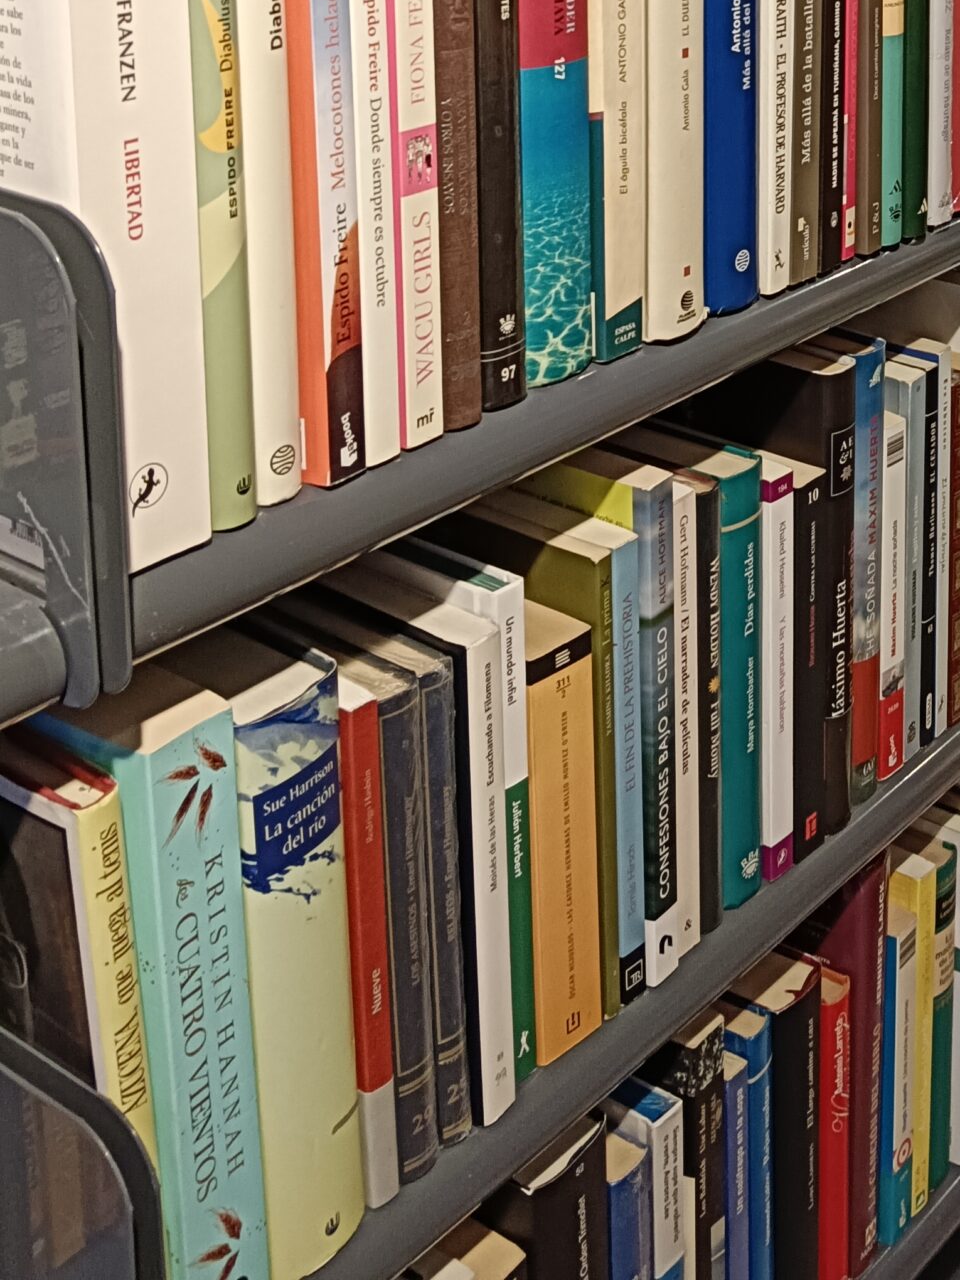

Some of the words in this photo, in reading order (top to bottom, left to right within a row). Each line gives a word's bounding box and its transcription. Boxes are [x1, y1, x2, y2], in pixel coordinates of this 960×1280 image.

[367, 39, 381, 93] Freire
[409, 34, 425, 106] FIONA
[553, 56, 566, 81] 127
[617, 23, 627, 83] ANTONIO
[776, 53, 787, 69] EL
[802, 54, 812, 70] la
[775, 72, 787, 133] PROFESOR
[802, 73, 812, 93] de
[325, 53, 347, 193] Melocotones
[369, 97, 385, 154] Donde
[619, 100, 628, 145] bicéfala
[802, 96, 812, 126] allá
[775, 135, 786, 152] DE
[801, 132, 812, 165] Más
[123, 136, 144, 242] LIBERTAD
[371, 157, 386, 222] siempre
[619, 184, 628, 195] El
[775, 155, 786, 215] HARVARD
[333, 202, 349, 268] Freire
[374, 227, 385, 241] es
[412, 211, 433, 295] GIRLS
[375, 246, 387, 308] octubre
[335, 270, 356, 345] Espido
[614, 322, 637, 336] ESPASA
[414, 309, 434, 387] WACU
[500, 364, 516, 383] 97
[777, 482, 789, 494] 194
[808, 487, 819, 506] 10
[680, 514, 688, 540] Gert
[680, 546, 689, 607] Hofmann
[505, 616, 514, 634] Un
[681, 615, 690, 632] El
[505, 637, 516, 675] mundo
[656, 626, 668, 684] CIELO
[681, 635, 690, 694] narrador
[507, 677, 516, 706] infiel
[658, 689, 668, 712] EL
[681, 698, 690, 716] de
[658, 716, 671, 764] BAJO
[680, 719, 690, 775] películas
[262, 794, 288, 818] Sue
[289, 758, 335, 805] Harrison
[263, 819, 283, 843] La
[285, 782, 336, 829] canción
[282, 829, 306, 857] del
[308, 815, 328, 841] río
[512, 799, 521, 834] Julián
[658, 768, 671, 900] CONFESIONES
[513, 834, 522, 878] Herbert
[203, 846, 234, 1014] KRISTIN
[173, 911, 208, 1057] CUATRO
[216, 1019, 246, 1178] HANNAH
[411, 1106, 434, 1135] 29
[186, 1059, 218, 1204] VIENTOS
